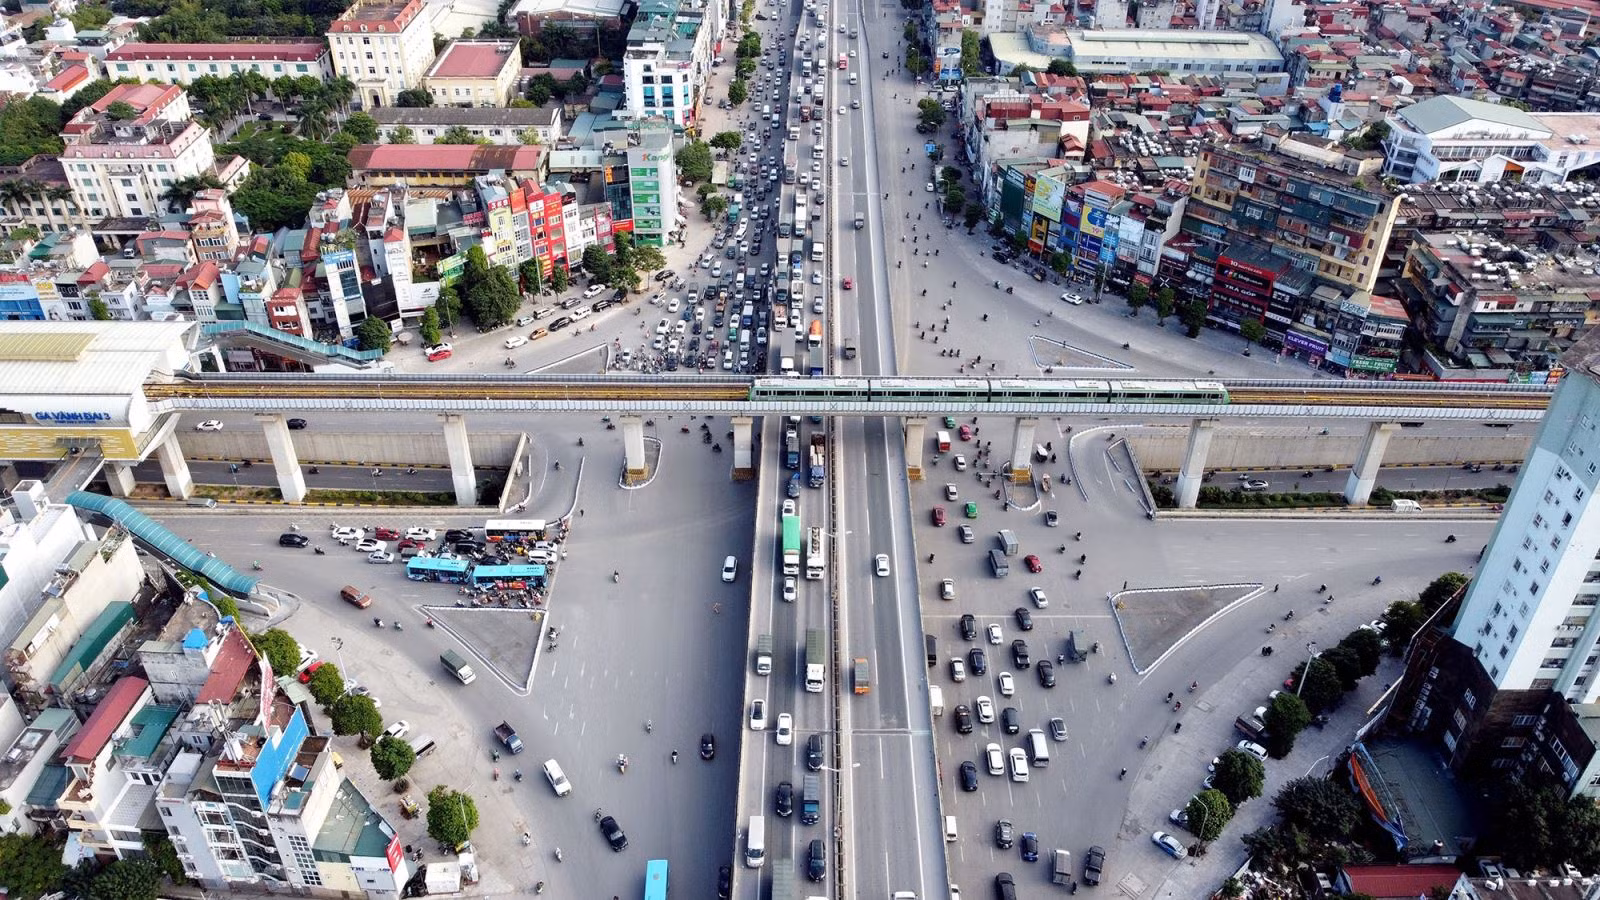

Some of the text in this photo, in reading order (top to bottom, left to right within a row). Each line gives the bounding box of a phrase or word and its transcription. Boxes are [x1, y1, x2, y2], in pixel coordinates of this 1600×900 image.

[35, 411, 52, 420] GA
[51, 410, 83, 420] VÀNH
[103, 412, 111, 420] 3
